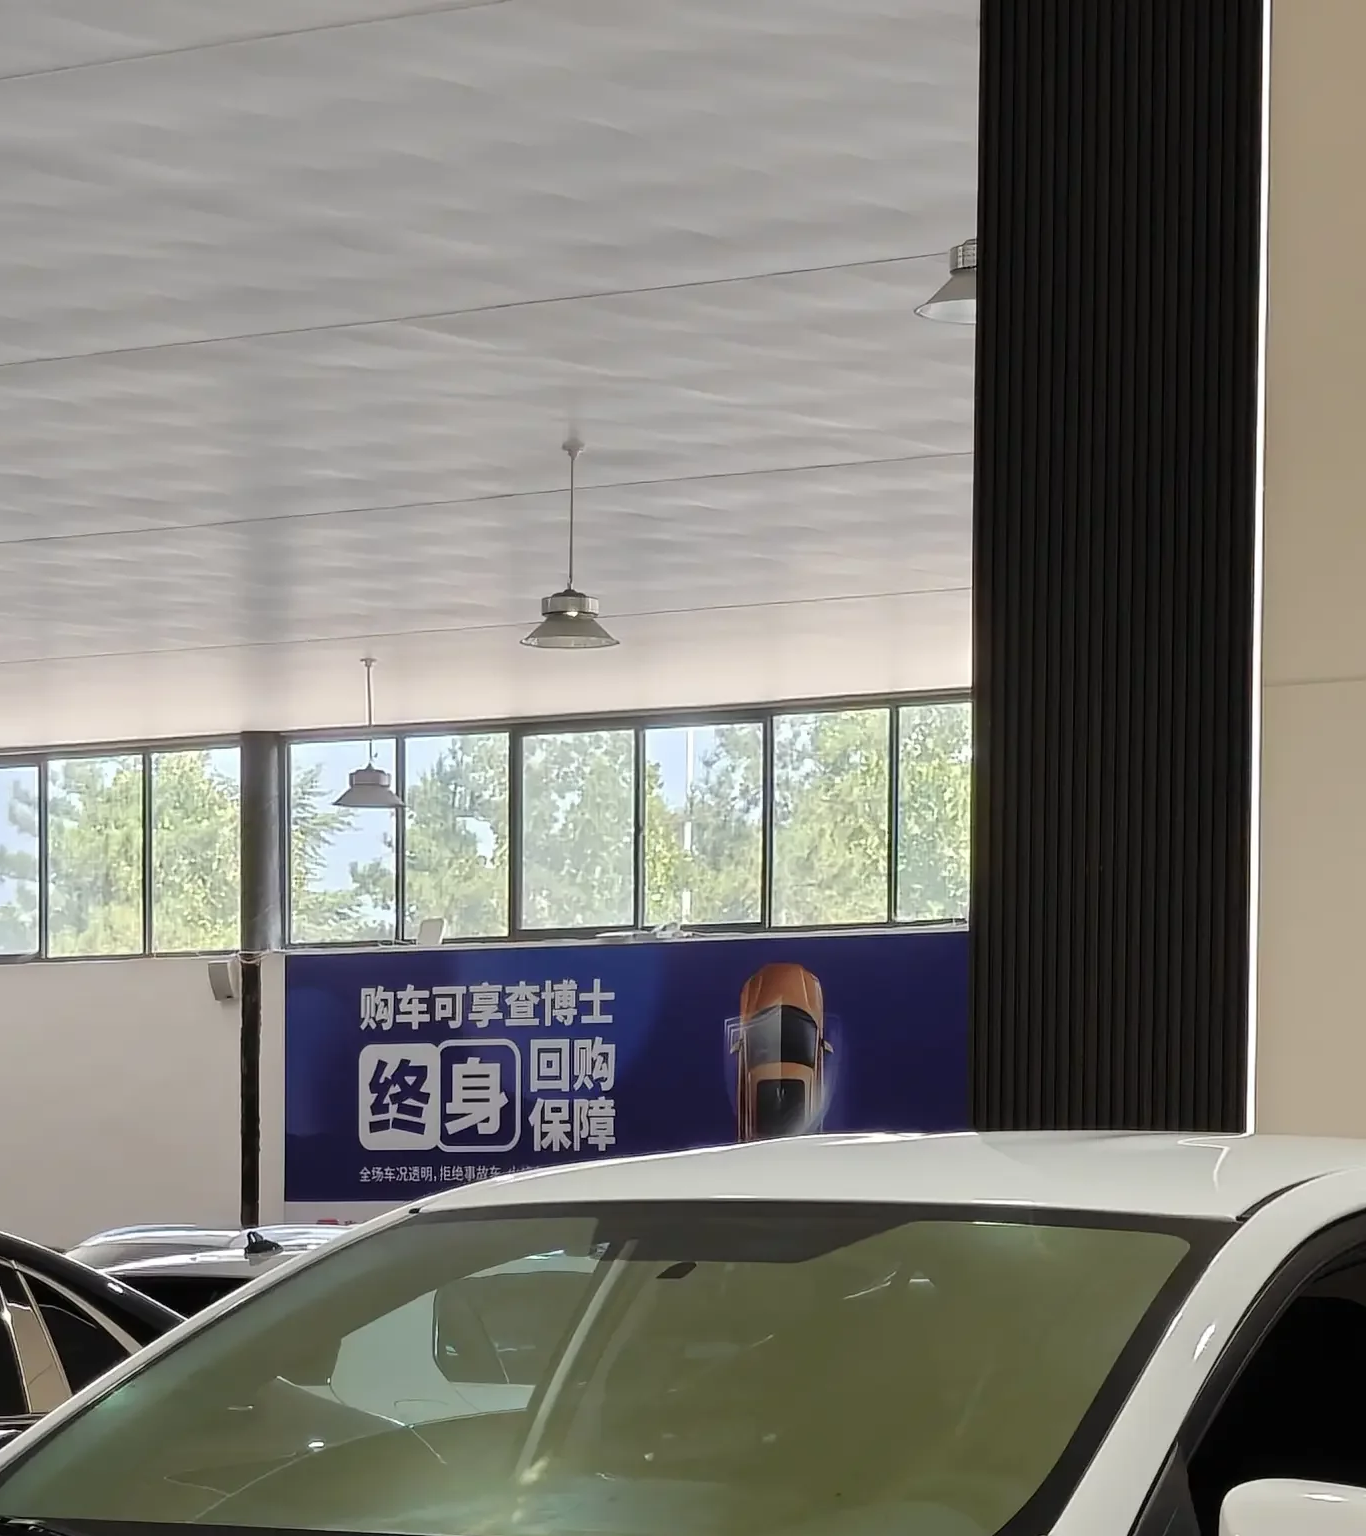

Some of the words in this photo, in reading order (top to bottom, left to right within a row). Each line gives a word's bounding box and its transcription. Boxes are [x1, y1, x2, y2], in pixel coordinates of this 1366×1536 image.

[360, 978, 616, 1031] 购车可享查博士
[530, 1036, 616, 1093] 回购
[368, 1056, 509, 1136] 终身
[528, 1095, 616, 1152] 保障
